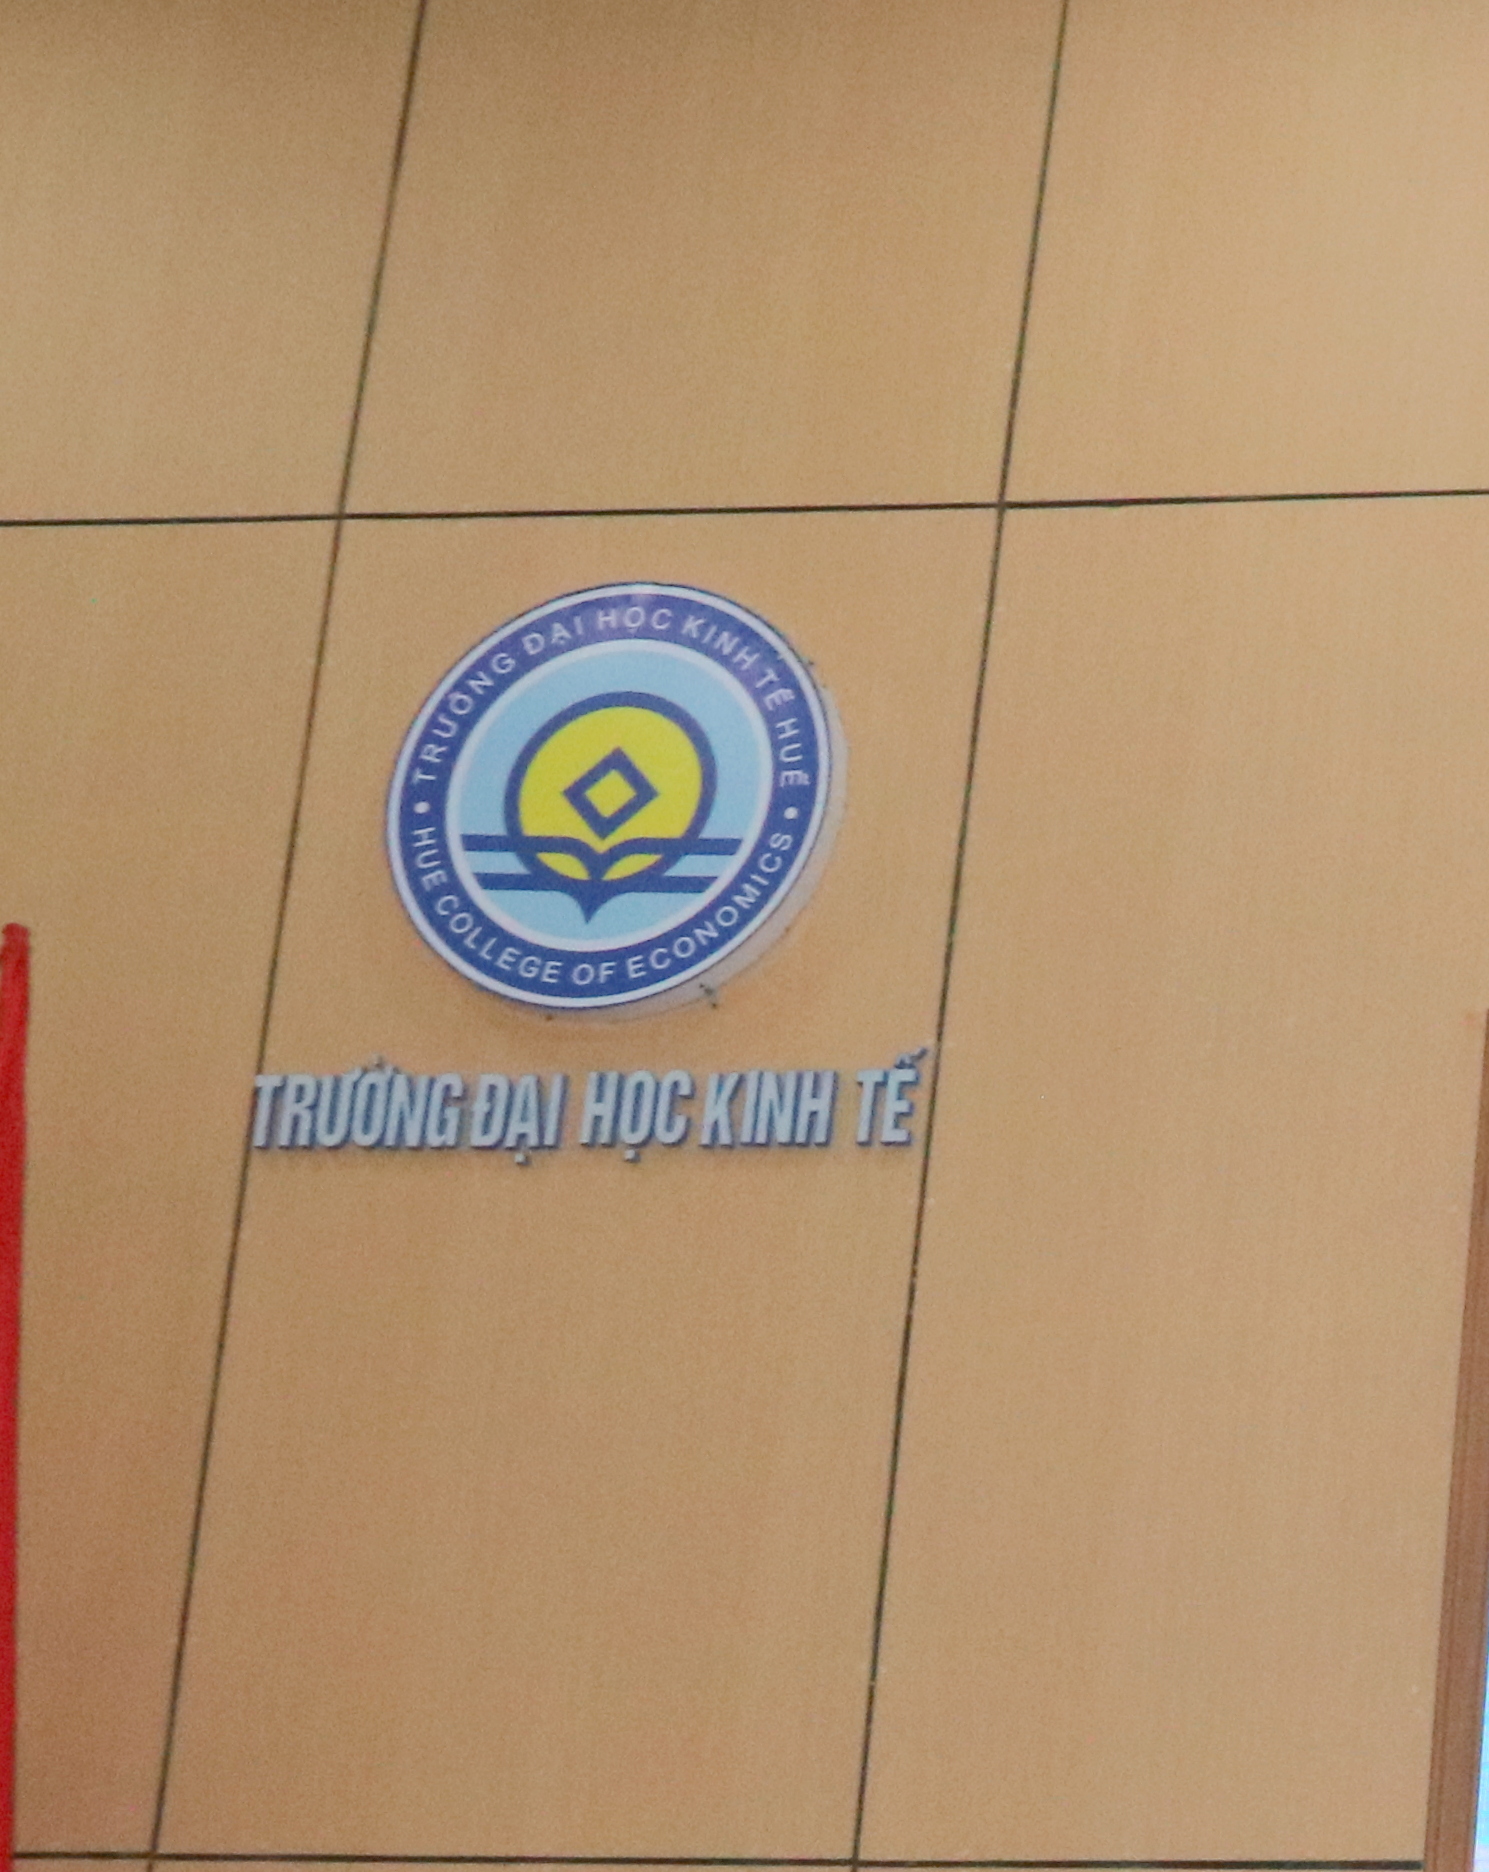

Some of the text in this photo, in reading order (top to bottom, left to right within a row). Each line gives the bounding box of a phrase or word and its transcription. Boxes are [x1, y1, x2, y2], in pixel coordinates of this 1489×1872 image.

[598, 606, 672, 634] HỌC
[681, 614, 760, 672] KINH
[411, 825, 793, 987] HUE COLLEGE OF ECONOMICS
[251, 1046, 930, 1165] TRƯỜNG ĐẠI HỌC KINH TẾ
